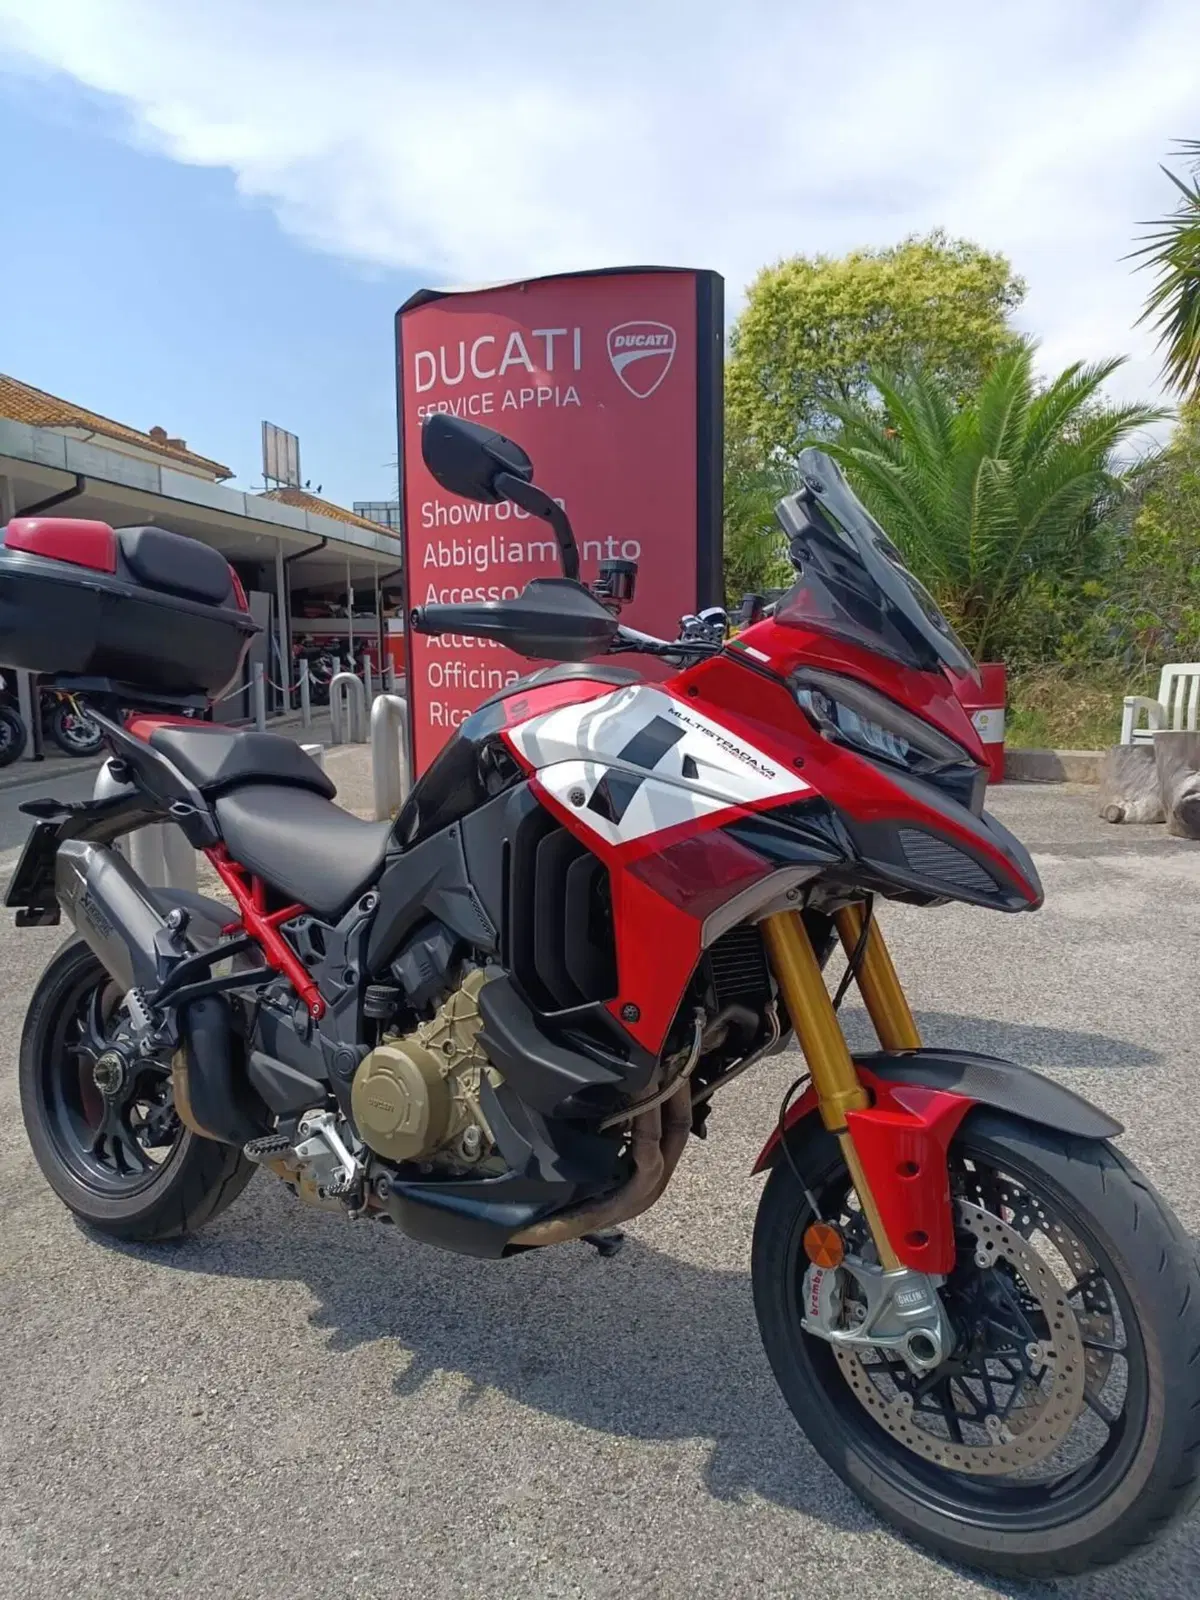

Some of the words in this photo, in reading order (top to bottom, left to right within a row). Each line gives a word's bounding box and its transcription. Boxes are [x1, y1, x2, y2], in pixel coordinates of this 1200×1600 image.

[614, 334, 670, 348] DUCATI
[414, 327, 581, 393] DUCATI
[501, 386, 581, 411] APPIA
[423, 536, 641, 571] Abbigliamnto
[425, 583, 528, 606] Accesso
[428, 662, 519, 689] Officina
[668, 707, 758, 766] MULTISTRADA
[761, 764, 776, 777] V4
[810, 1269, 824, 1316] brembo
